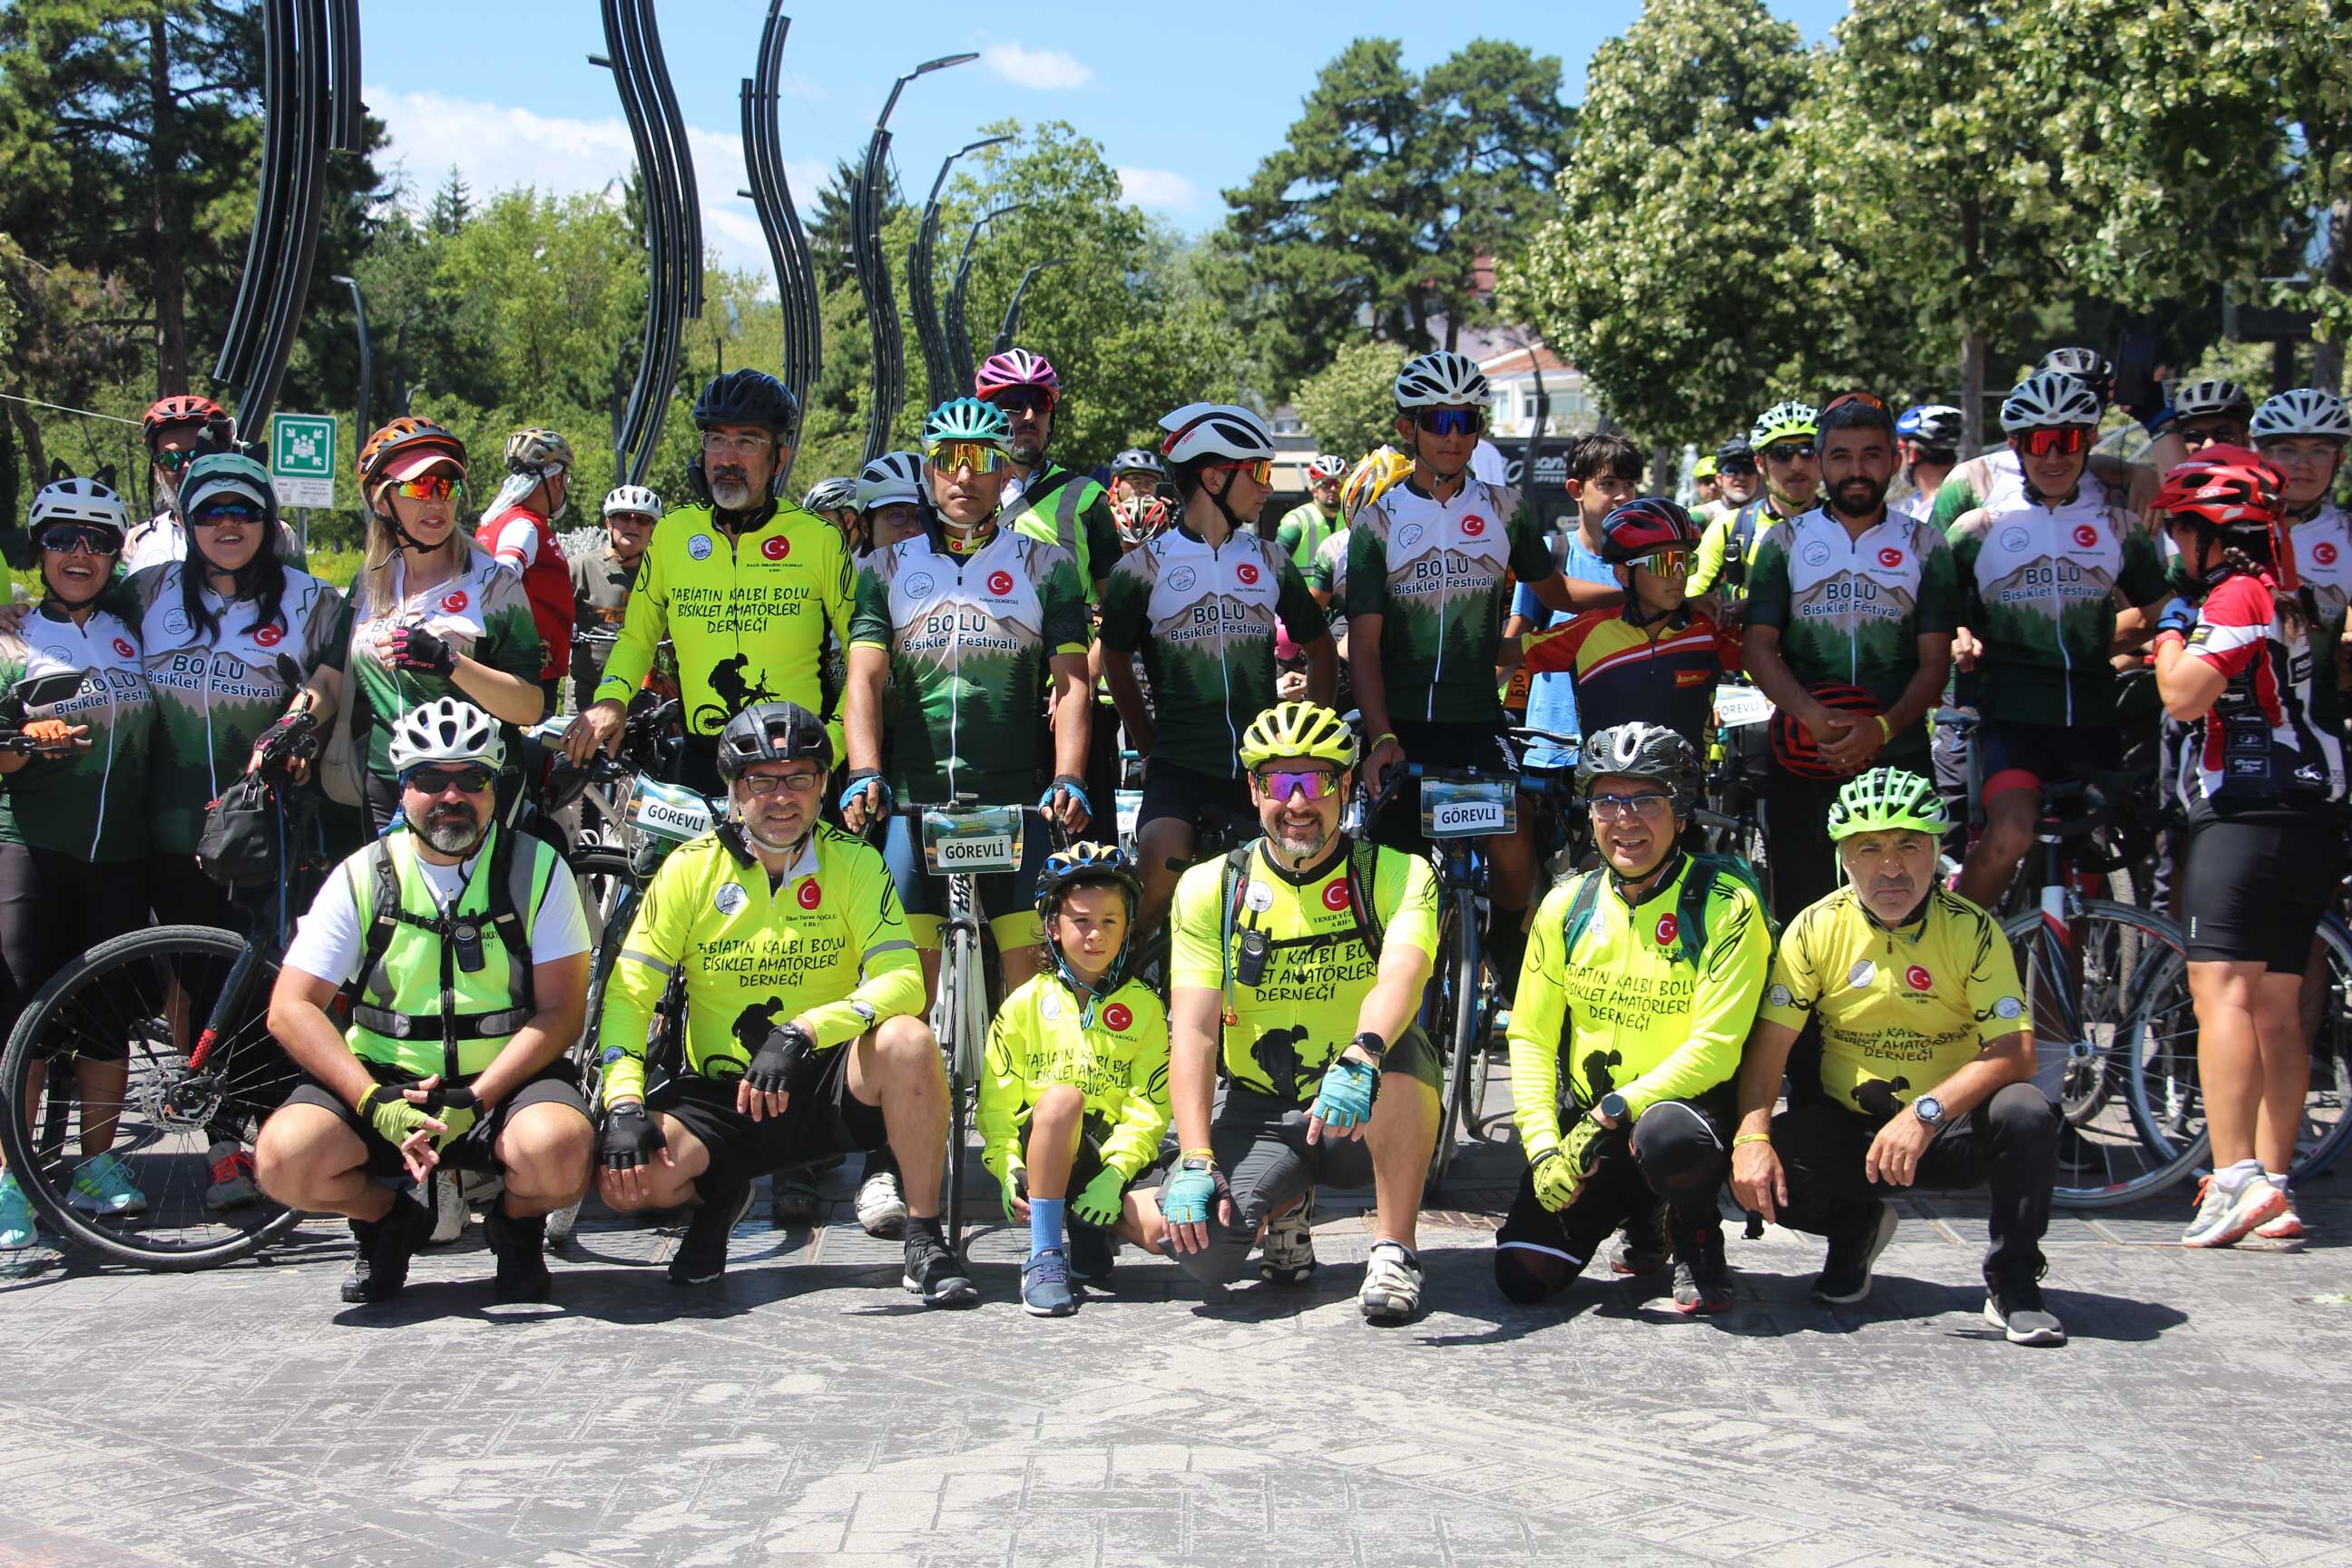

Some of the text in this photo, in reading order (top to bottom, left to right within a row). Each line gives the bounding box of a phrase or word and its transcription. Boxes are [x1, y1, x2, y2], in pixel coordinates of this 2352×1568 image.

[1416, 557, 1469, 579] BOLU
[2025, 565, 2081, 584] BOLU
[671, 585, 810, 602] TABİATIN KALBİ BOLU
[1394, 573, 1494, 595] Bisiklet Festivali
[1827, 582, 1877, 600] BOLU
[2003, 586, 2053, 602] Bisiklet
[678, 601, 801, 618] BİSİKLET AMATÖRLERİ
[1192, 603, 1246, 624] BOLU
[1802, 603, 1848, 616] Bisiklet
[707, 617, 769, 633] DERNEĞİ
[926, 613, 987, 634] BOLU
[1171, 622, 1269, 641] Bisiklet Festivali
[904, 633, 1017, 652] Bisiklet Festivali
[172, 654, 246, 680] BOLU
[81, 673, 137, 695] BOLU
[147, 670, 280, 699] Bisiklet Festivali
[54, 690, 152, 715] Bisiklet Festiv
[1442, 805, 1496, 824] GÖREVLİ
[945, 839, 1004, 859] GÖREVLİ
[763, 936, 804, 954] KALBİ
[811, 935, 846, 953] BOLU
[703, 950, 838, 972] BİSİKLET AMATÖRLERİ
[739, 972, 804, 987] DERNEĞİ
[1616, 973, 1653, 994] KALBİ
[1256, 984, 1337, 1003] DERNEĞİ
[1608, 990, 1691, 1015] AMATÖRLERİ
[1589, 1004, 1651, 1032] DERNEĞİ
[1864, 1046, 1934, 1062] DERNEĞİ
